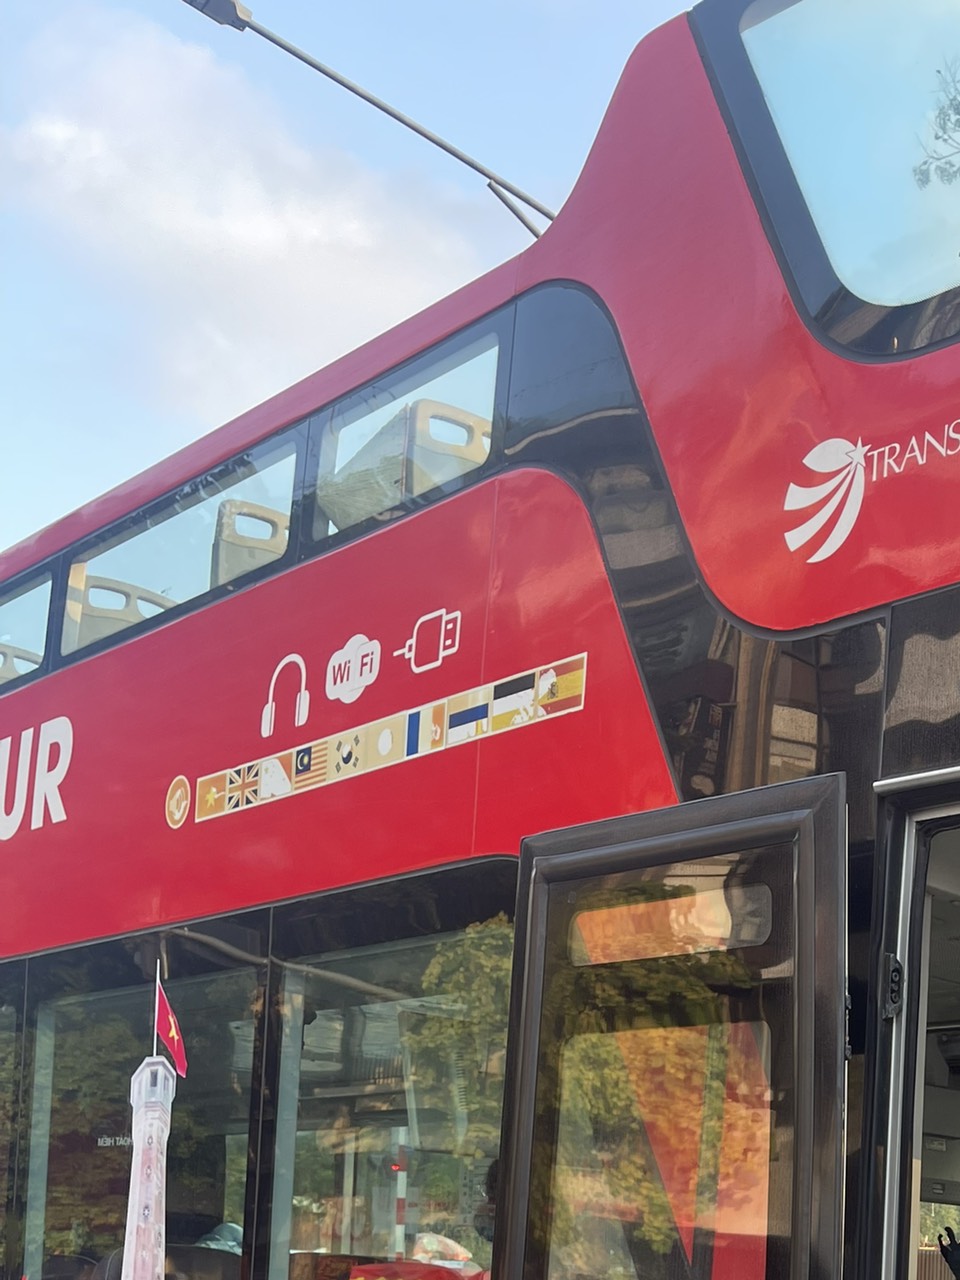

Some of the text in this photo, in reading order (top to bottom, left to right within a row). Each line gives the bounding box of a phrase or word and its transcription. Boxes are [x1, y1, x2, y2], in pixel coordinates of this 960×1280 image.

[332, 650, 374, 687] Wi Fi
[0, 715, 74, 841] UR
